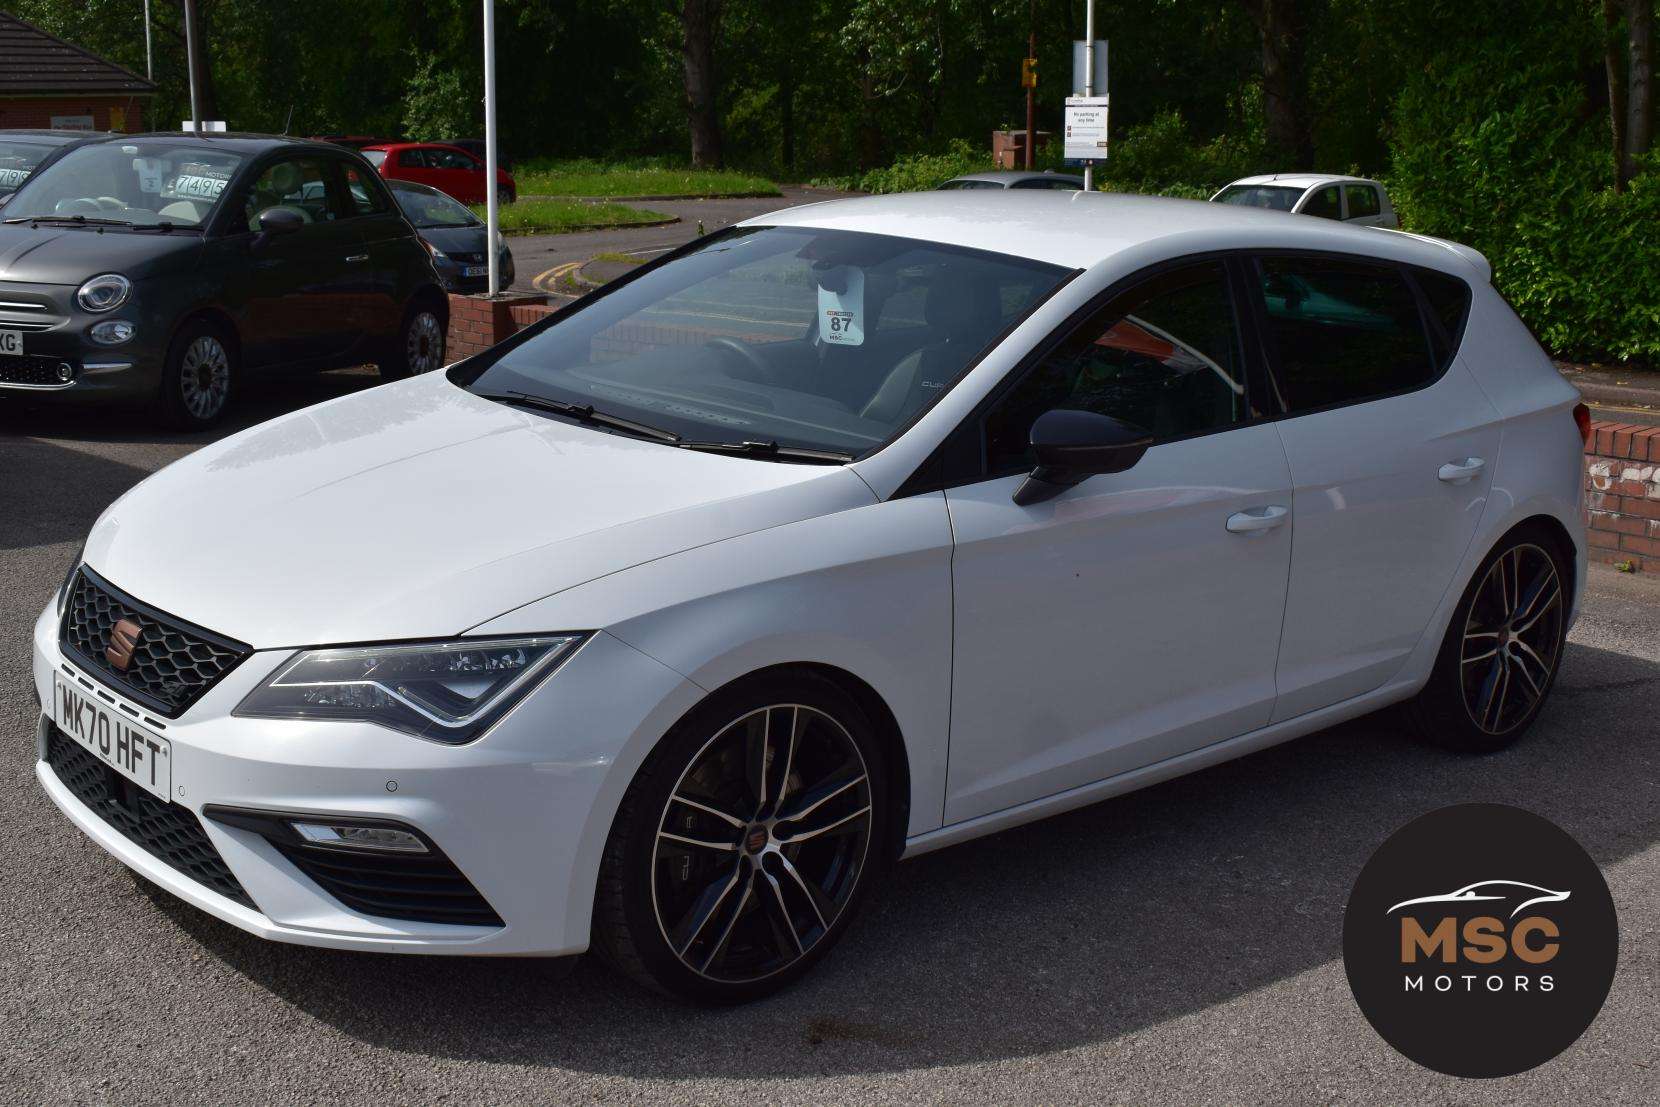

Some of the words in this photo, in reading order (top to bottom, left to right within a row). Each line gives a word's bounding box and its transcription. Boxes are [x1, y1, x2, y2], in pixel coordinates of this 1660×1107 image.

[830, 317, 851, 332] 87
[62, 684, 111, 756] MK70
[116, 721, 161, 787] HFT
